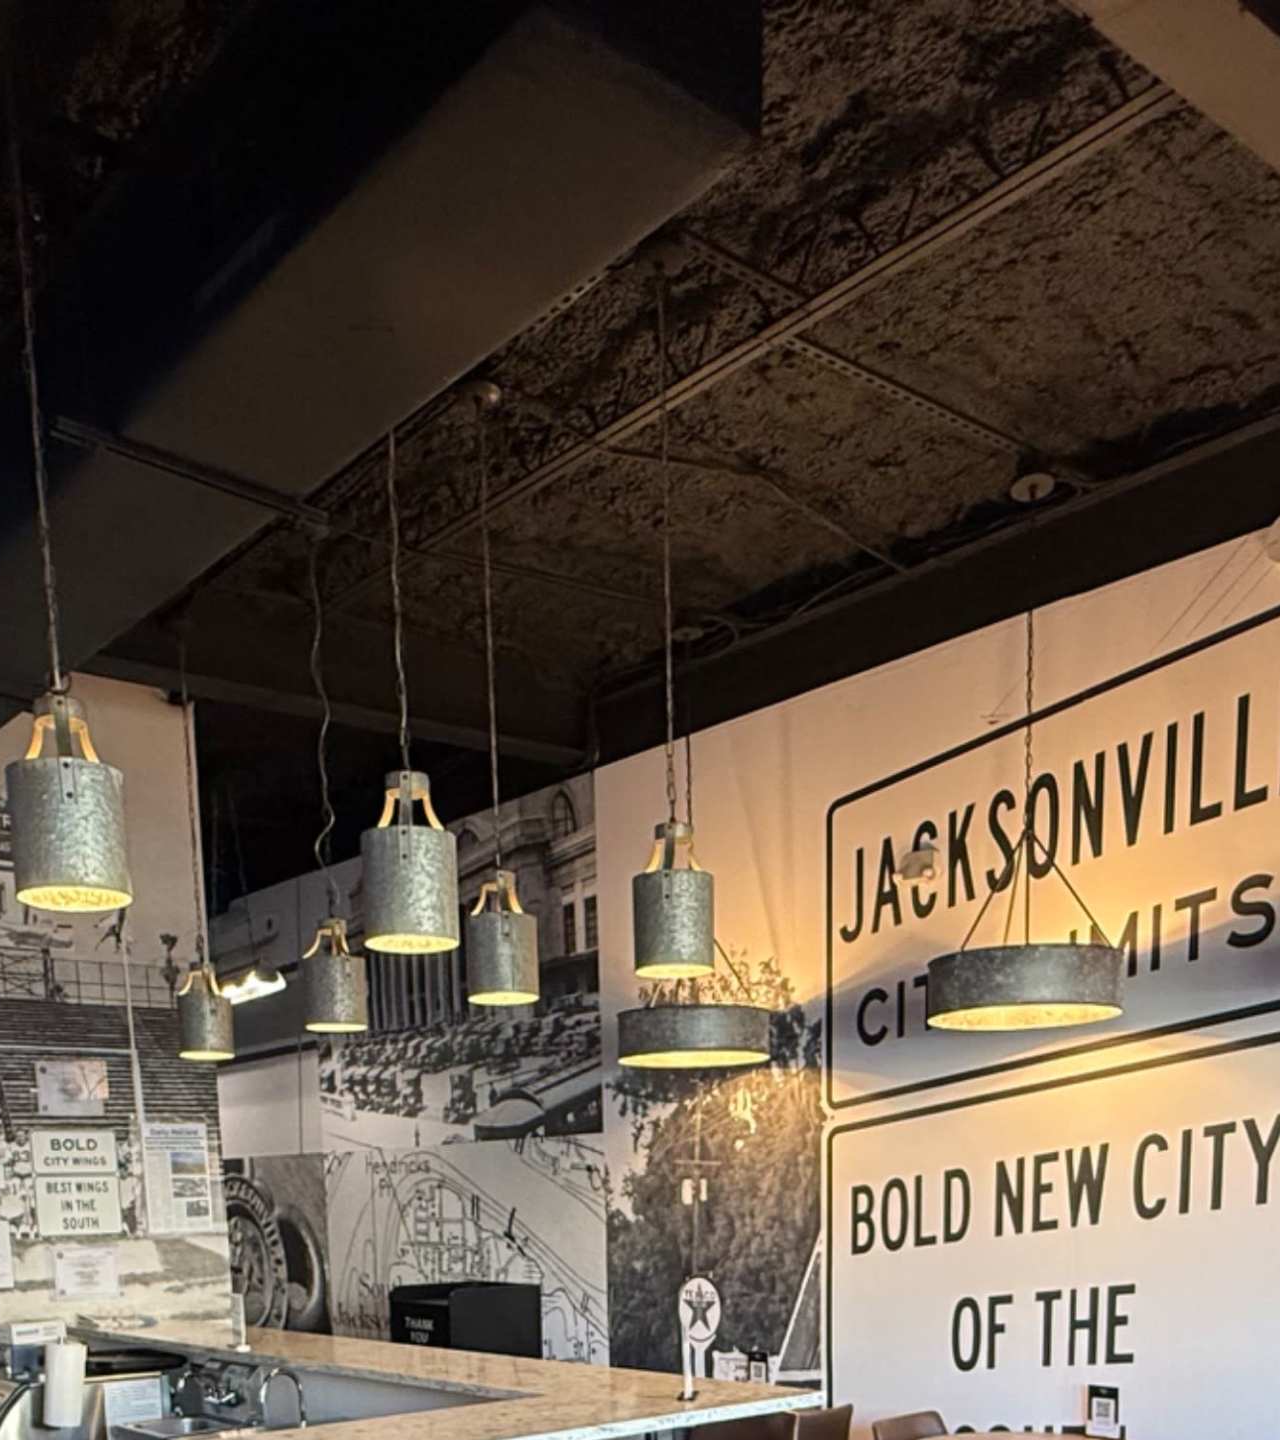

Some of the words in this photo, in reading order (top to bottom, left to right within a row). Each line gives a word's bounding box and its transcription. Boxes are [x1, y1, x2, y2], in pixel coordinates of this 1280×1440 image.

[50, 1138, 98, 1151] BOLD
[850, 1167, 971, 1255] BOLD
[994, 1142, 1110, 1237] NEW
[76, 1200, 96, 1212] THE
[62, 1217, 100, 1230] SOUTH
[951, 1294, 1014, 1372] OF
[1035, 1284, 1136, 1367] THE
